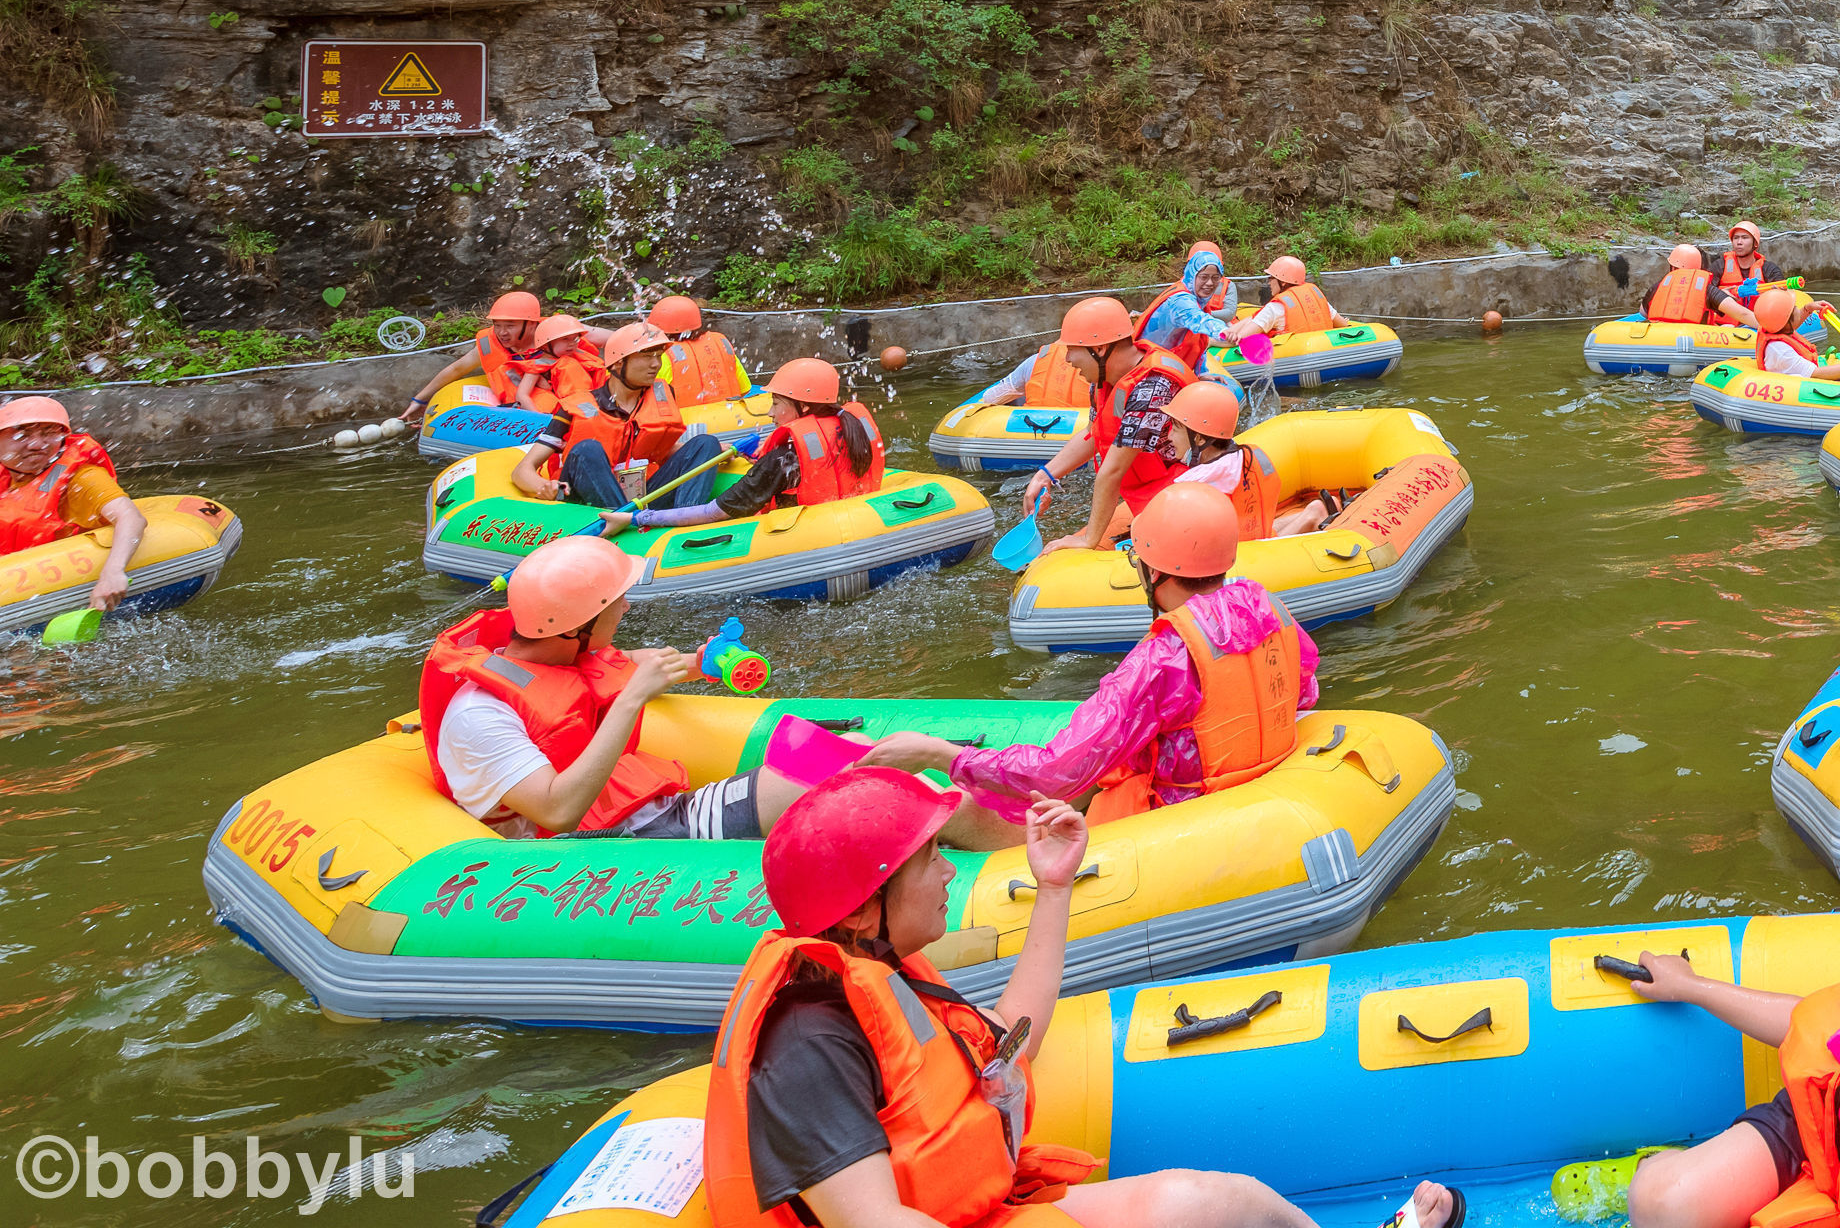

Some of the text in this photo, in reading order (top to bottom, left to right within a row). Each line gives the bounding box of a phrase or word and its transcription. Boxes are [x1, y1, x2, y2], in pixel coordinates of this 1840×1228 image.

[321, 51, 341, 123] 温馨提示
[1695, 331, 1729, 346] 0220
[1744, 382, 1785, 402] 043
[230, 799, 317, 873] 0015
